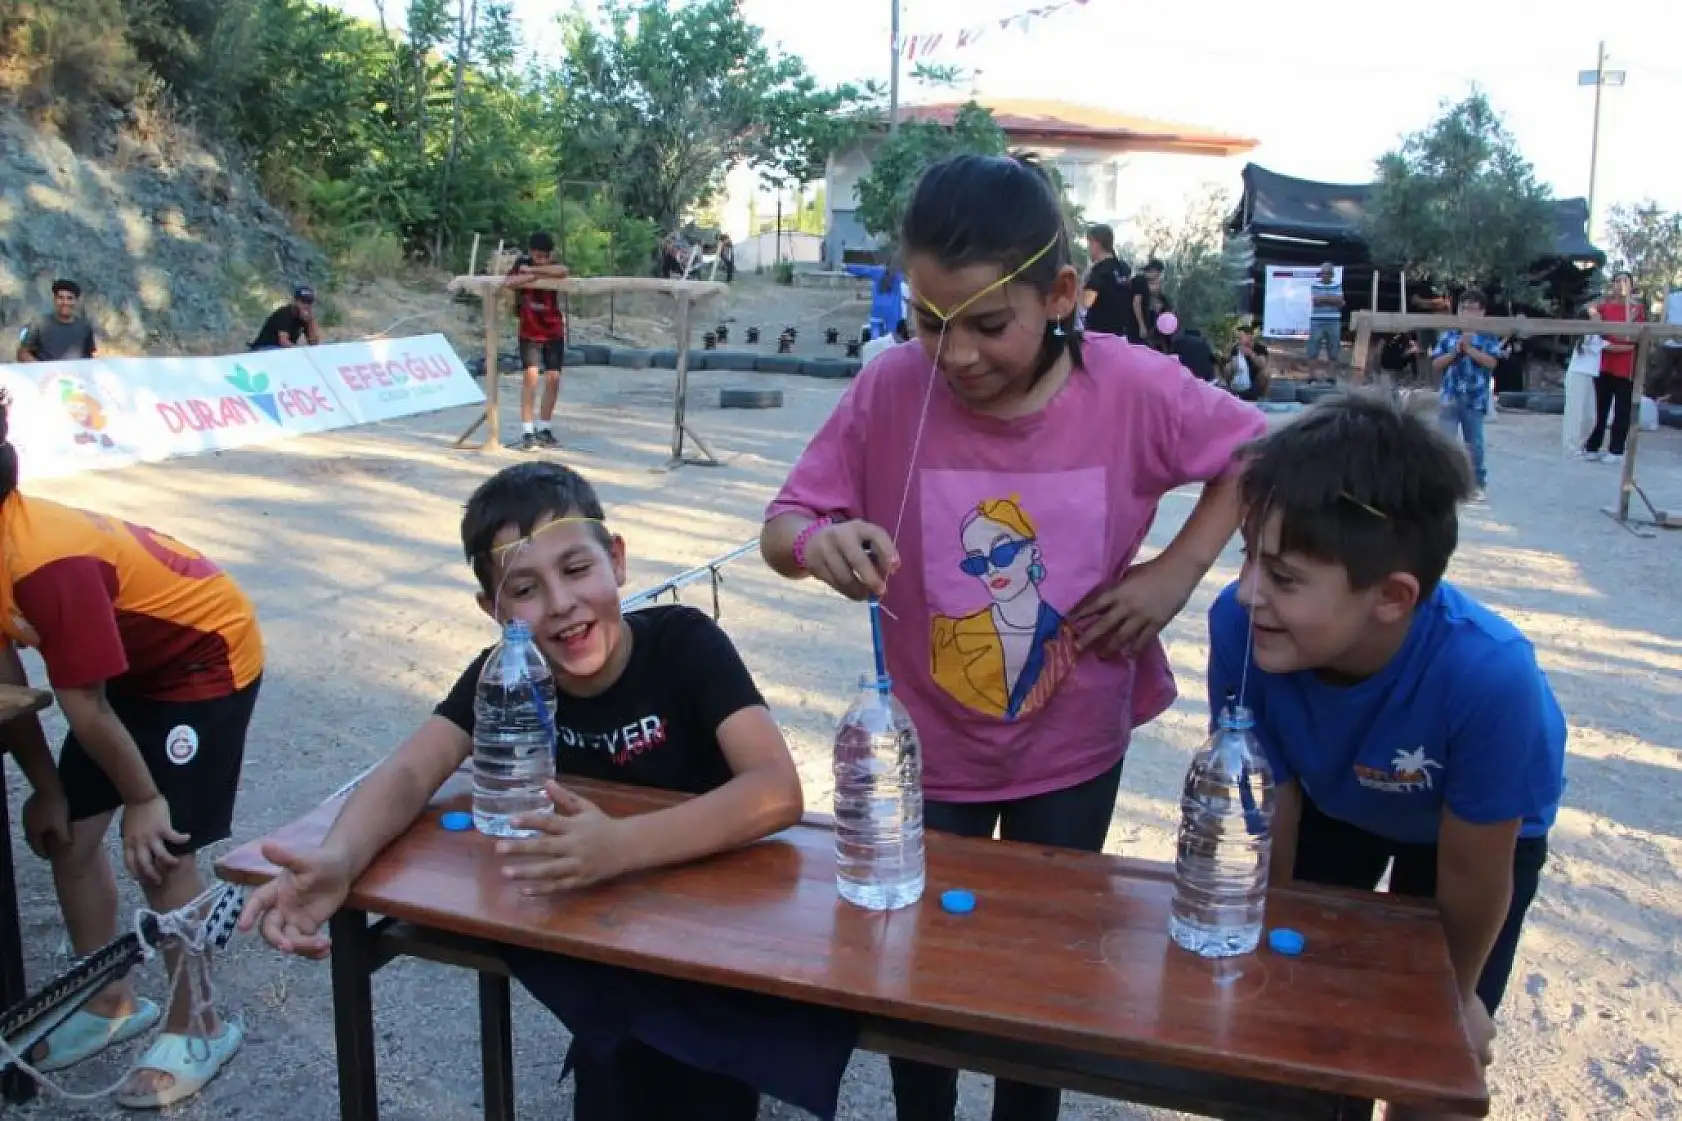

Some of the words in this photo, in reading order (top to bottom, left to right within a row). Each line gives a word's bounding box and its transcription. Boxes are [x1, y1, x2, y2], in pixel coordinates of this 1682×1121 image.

[337, 352, 453, 391] EFEOĞLU
[156, 395, 261, 434] DURAN
[556, 713, 662, 755] OVER
